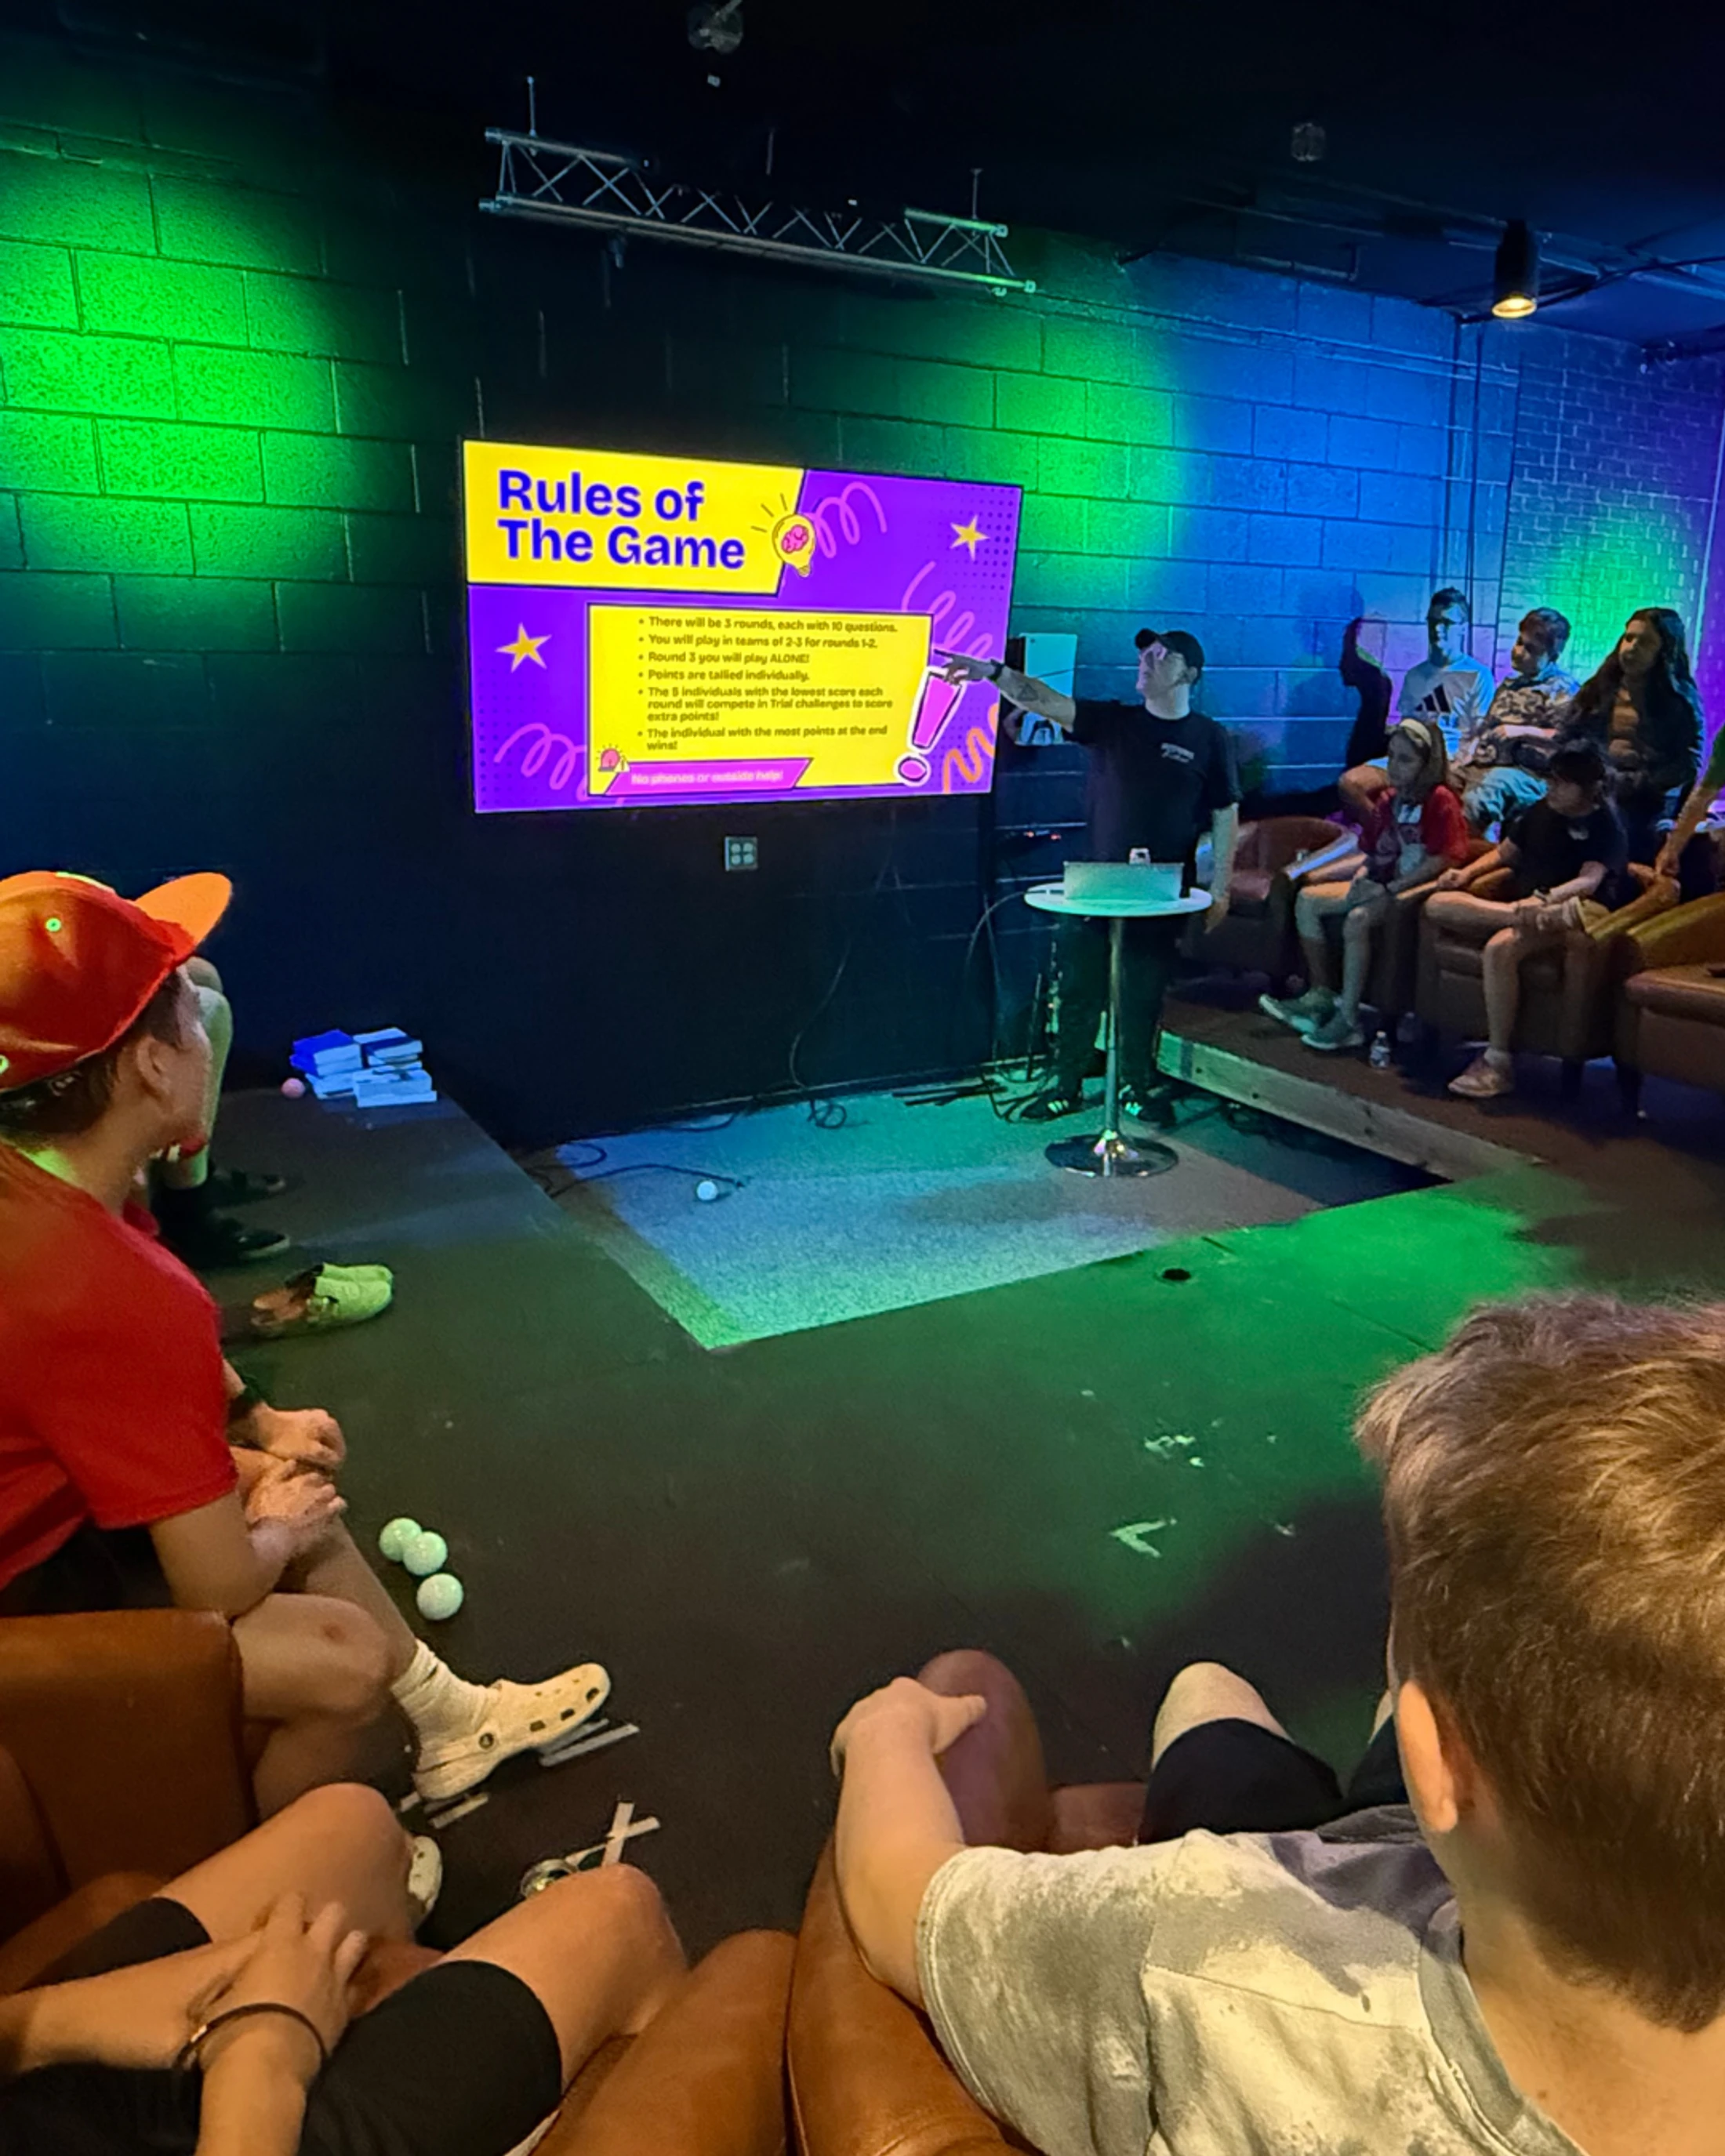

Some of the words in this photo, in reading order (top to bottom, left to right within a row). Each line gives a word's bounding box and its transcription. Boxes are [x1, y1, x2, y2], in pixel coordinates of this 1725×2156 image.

[499, 470, 641, 518] Rules
[655, 481, 704, 521] of
[497, 517, 593, 562] The
[608, 525, 745, 569] Game
[649, 616, 682, 626] There
[685, 617, 705, 627] will
[708, 618, 721, 627] be
[724, 619, 732, 627] 3
[734, 619, 775, 630] rounds,
[778, 620, 804, 630] each
[807, 621, 829, 630] with
[832, 622, 842, 630] 10
[845, 622, 897, 633] questions.
[648, 634, 670, 644] You
[674, 634, 693, 644] will
[695, 636, 720, 647] play
[723, 635, 732, 644] in
[735, 637, 768, 646] teams
[772, 637, 783, 646] of
[786, 637, 802, 647] 2-3
[805, 638, 820, 647] for
[823, 638, 859, 647] rounds
[648, 652, 686, 662] Round
[689, 652, 695, 662] 3
[699, 655, 720, 664] you
[723, 652, 742, 662] will
[745, 653, 767, 665] play
[770, 654, 809, 663] ALONE!
[648, 670, 685, 679] Points
[709, 670, 743, 680] tallied
[746, 670, 809, 682] individually.
[648, 687, 668, 696] The
[682, 686, 742, 696] individuals
[745, 687, 768, 696] with
[772, 687, 788, 696] the
[791, 687, 825, 696] lowest
[859, 687, 883, 696] each
[648, 699, 682, 709] round
[685, 699, 704, 709] will
[707, 701, 755, 710] compete
[771, 699, 793, 708] Trial
[796, 699, 850, 710] challenges
[853, 699, 862, 708] to
[648, 713, 677, 721] extra
[681, 712, 719, 722] points!
[648, 728, 668, 738] The
[671, 728, 725, 737] individual
[728, 728, 751, 736] with
[754, 728, 771, 736] the
[775, 728, 801, 736] most
[804, 726, 835, 738] points
[851, 726, 866, 735] the
[869, 725, 887, 735] end
[647, 740, 677, 750] wins!
[631, 774, 648, 784] No
[652, 773, 694, 786] phones
[697, 773, 710, 782] or
[712, 771, 754, 782] outside
